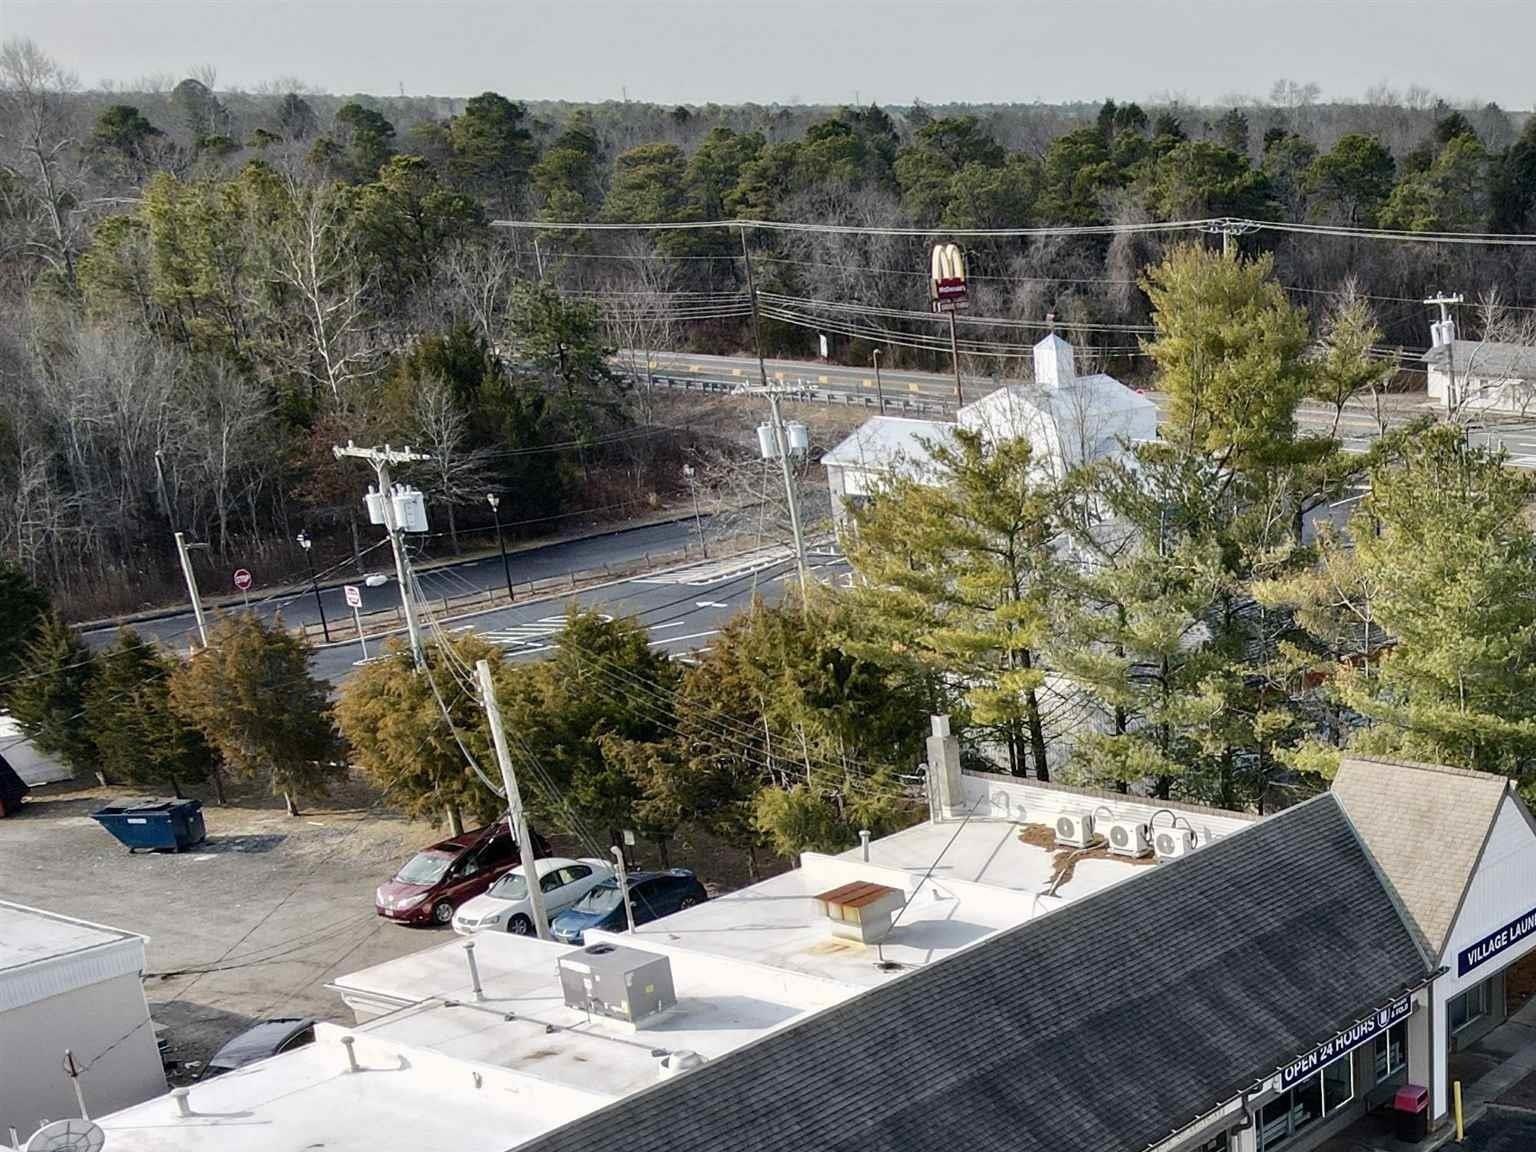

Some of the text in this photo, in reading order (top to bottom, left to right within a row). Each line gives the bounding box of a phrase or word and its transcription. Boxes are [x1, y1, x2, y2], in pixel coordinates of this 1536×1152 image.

[1468, 930, 1508, 966] VILLAGE
[1284, 1017, 1376, 1082] OPEN 24 HOURS
